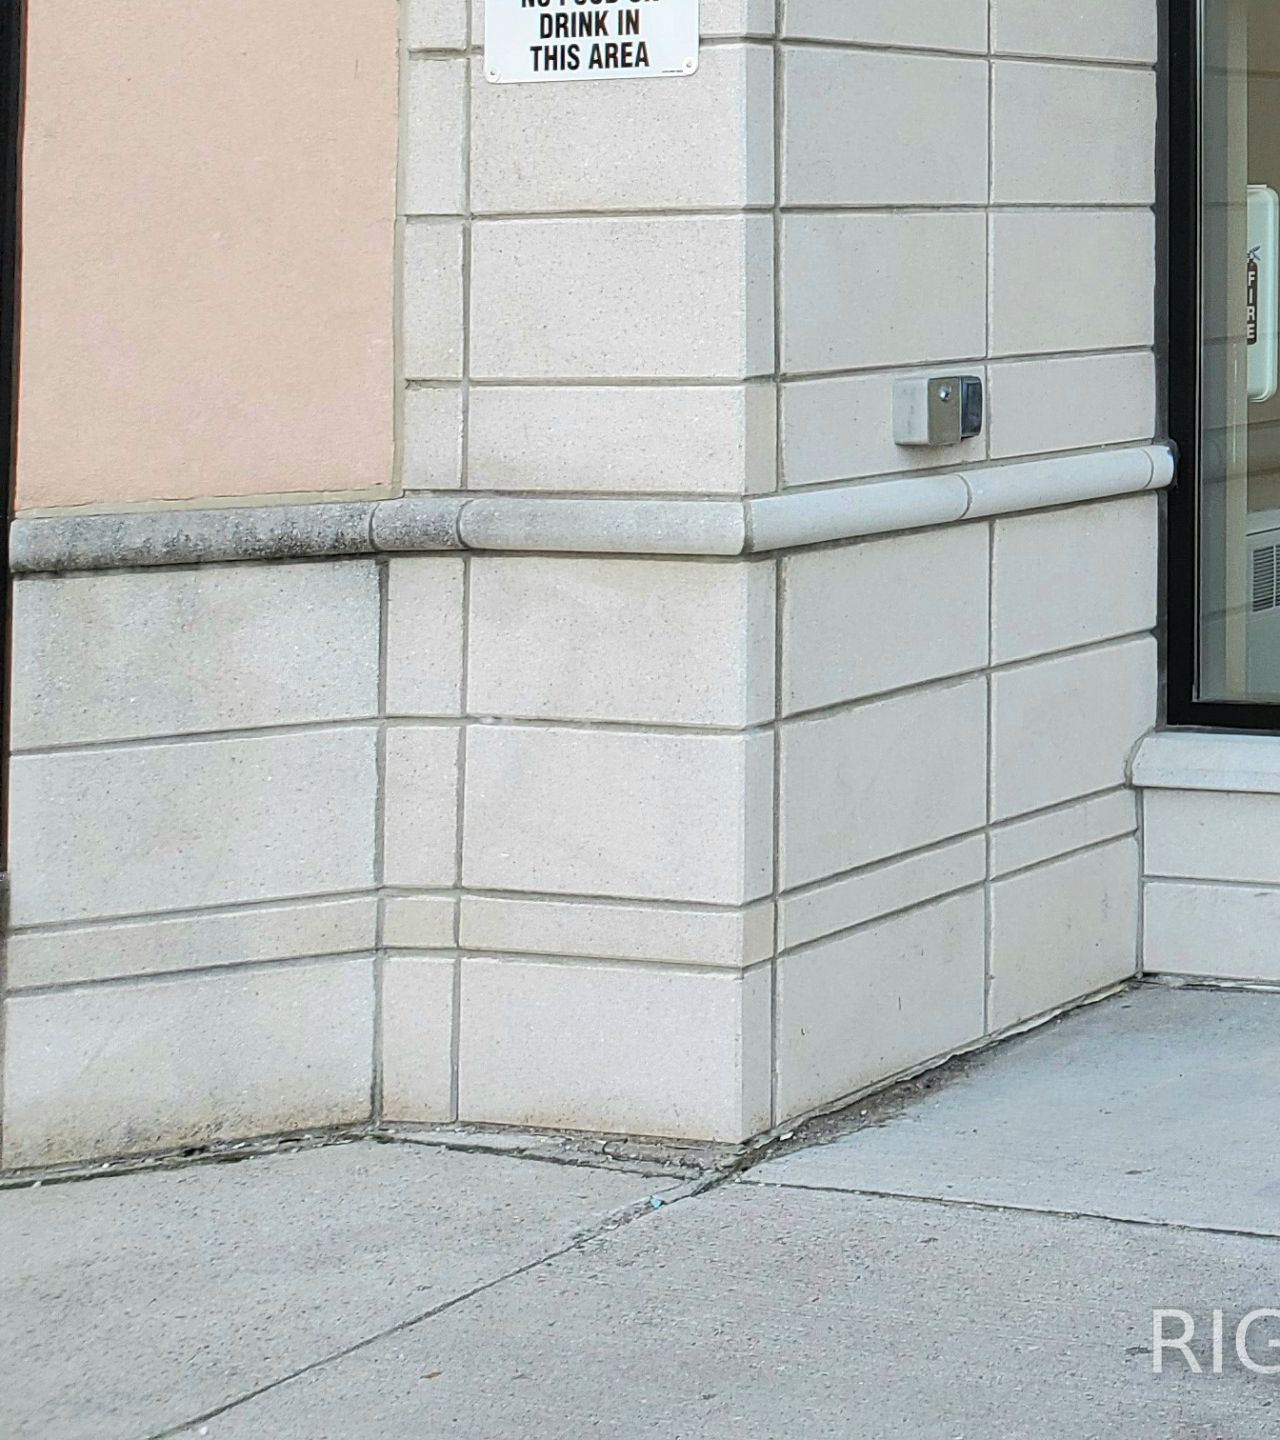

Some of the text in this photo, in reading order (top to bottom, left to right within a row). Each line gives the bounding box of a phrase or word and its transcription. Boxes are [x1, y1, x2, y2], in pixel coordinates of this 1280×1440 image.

[539, 9, 640, 39] DRINK IN
[530, 41, 650, 73] THIS AREA
[1247, 271, 1255, 339] FIRE
